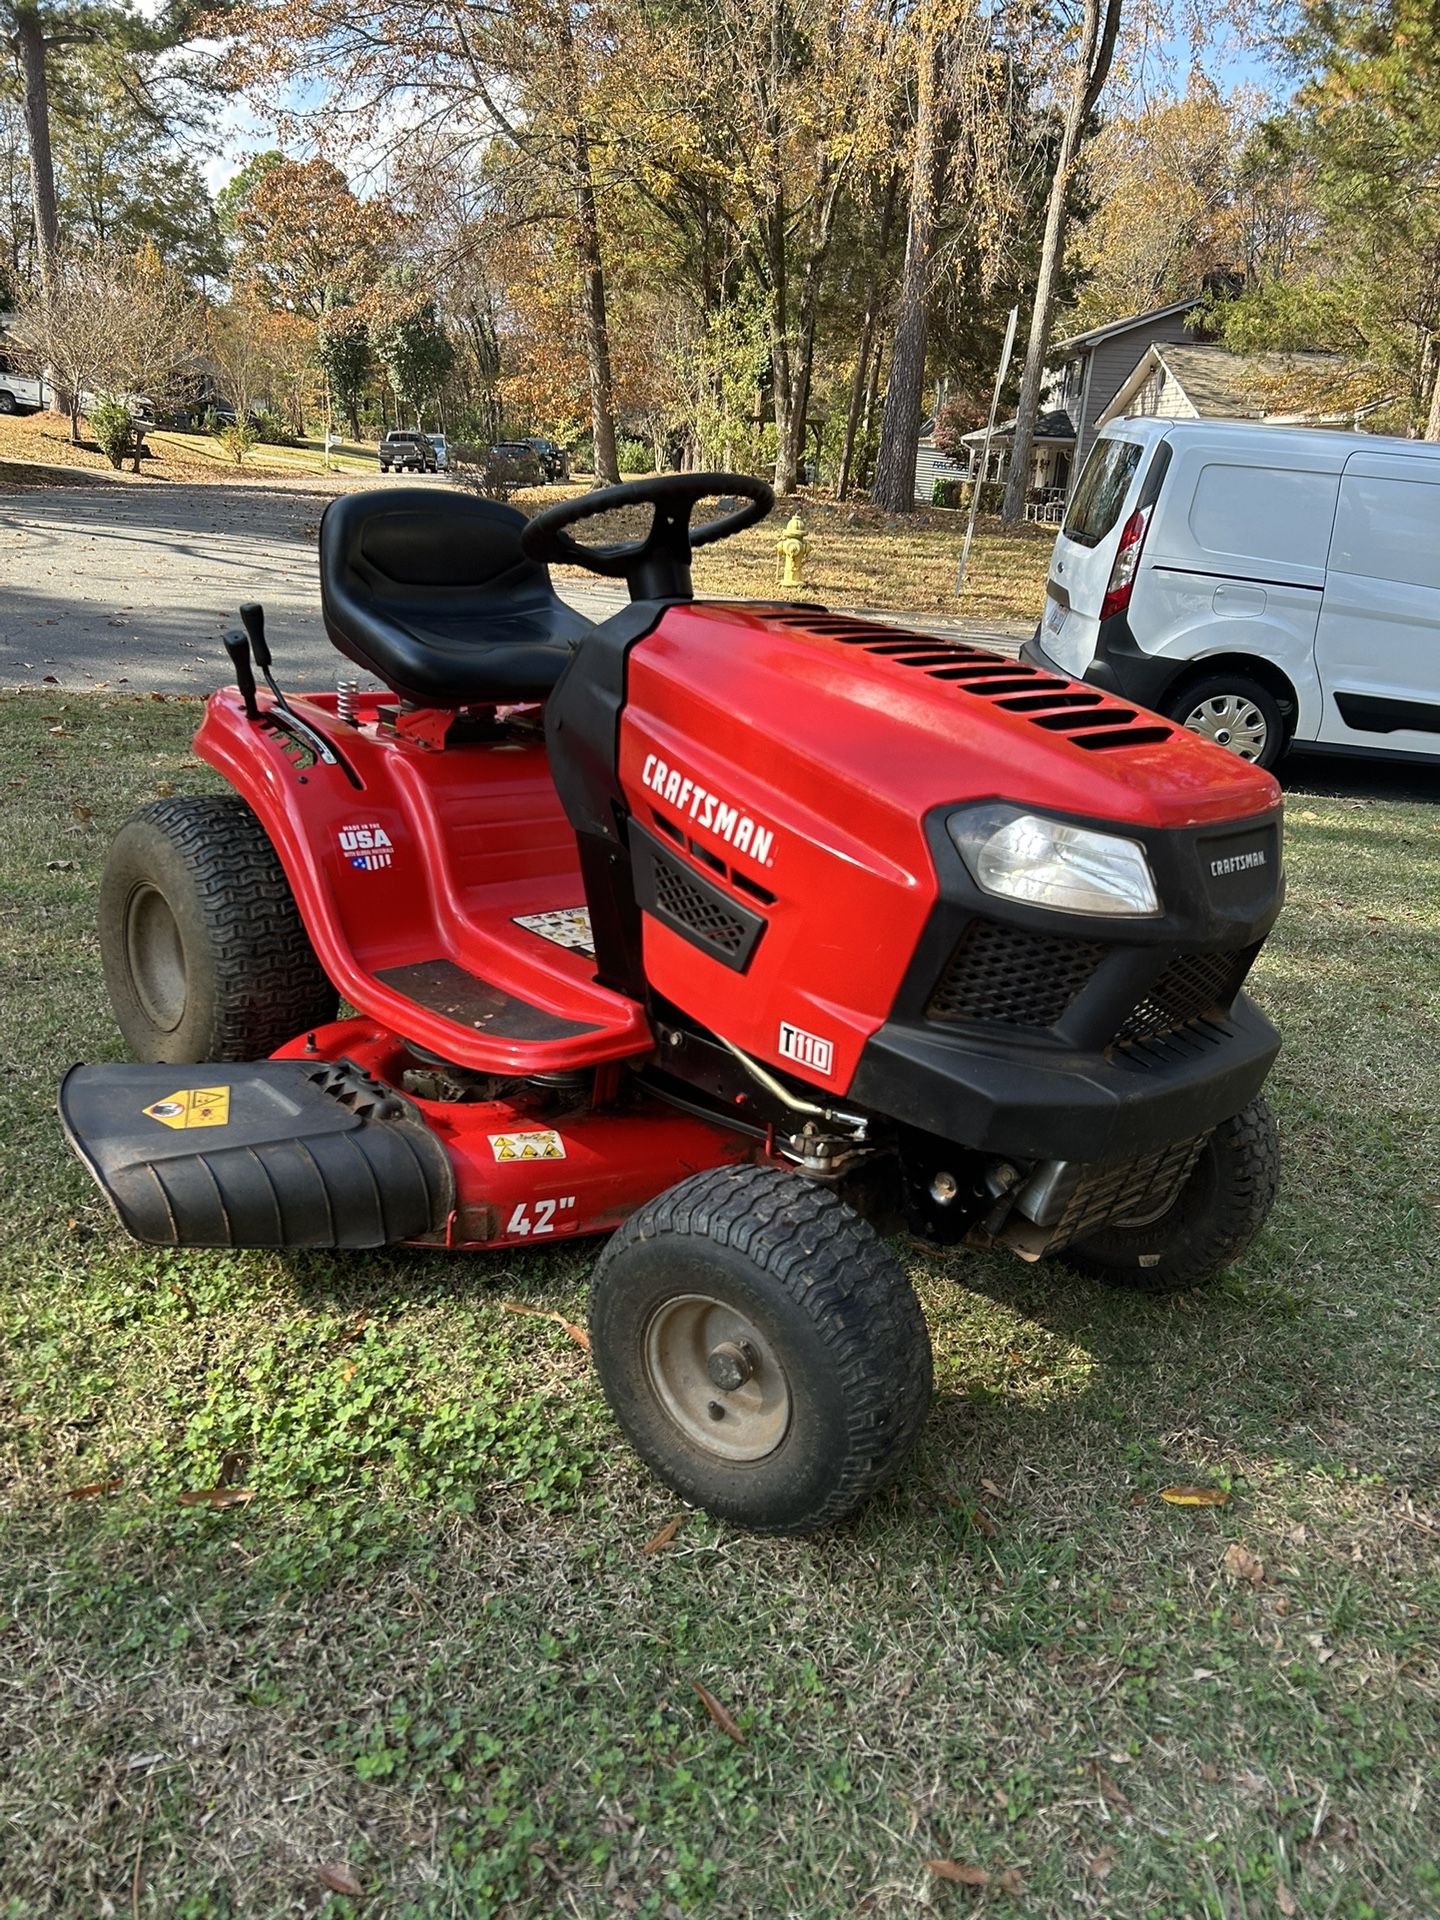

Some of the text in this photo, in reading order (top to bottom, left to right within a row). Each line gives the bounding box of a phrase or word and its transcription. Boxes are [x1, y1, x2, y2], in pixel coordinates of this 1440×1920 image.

[642, 753, 774, 864] CRAFTSMAN
[338, 829, 392, 850] USA
[1210, 850, 1265, 877] CRAFTSMAN
[783, 1026, 830, 1070] T110
[506, 1196, 576, 1235] 42"
